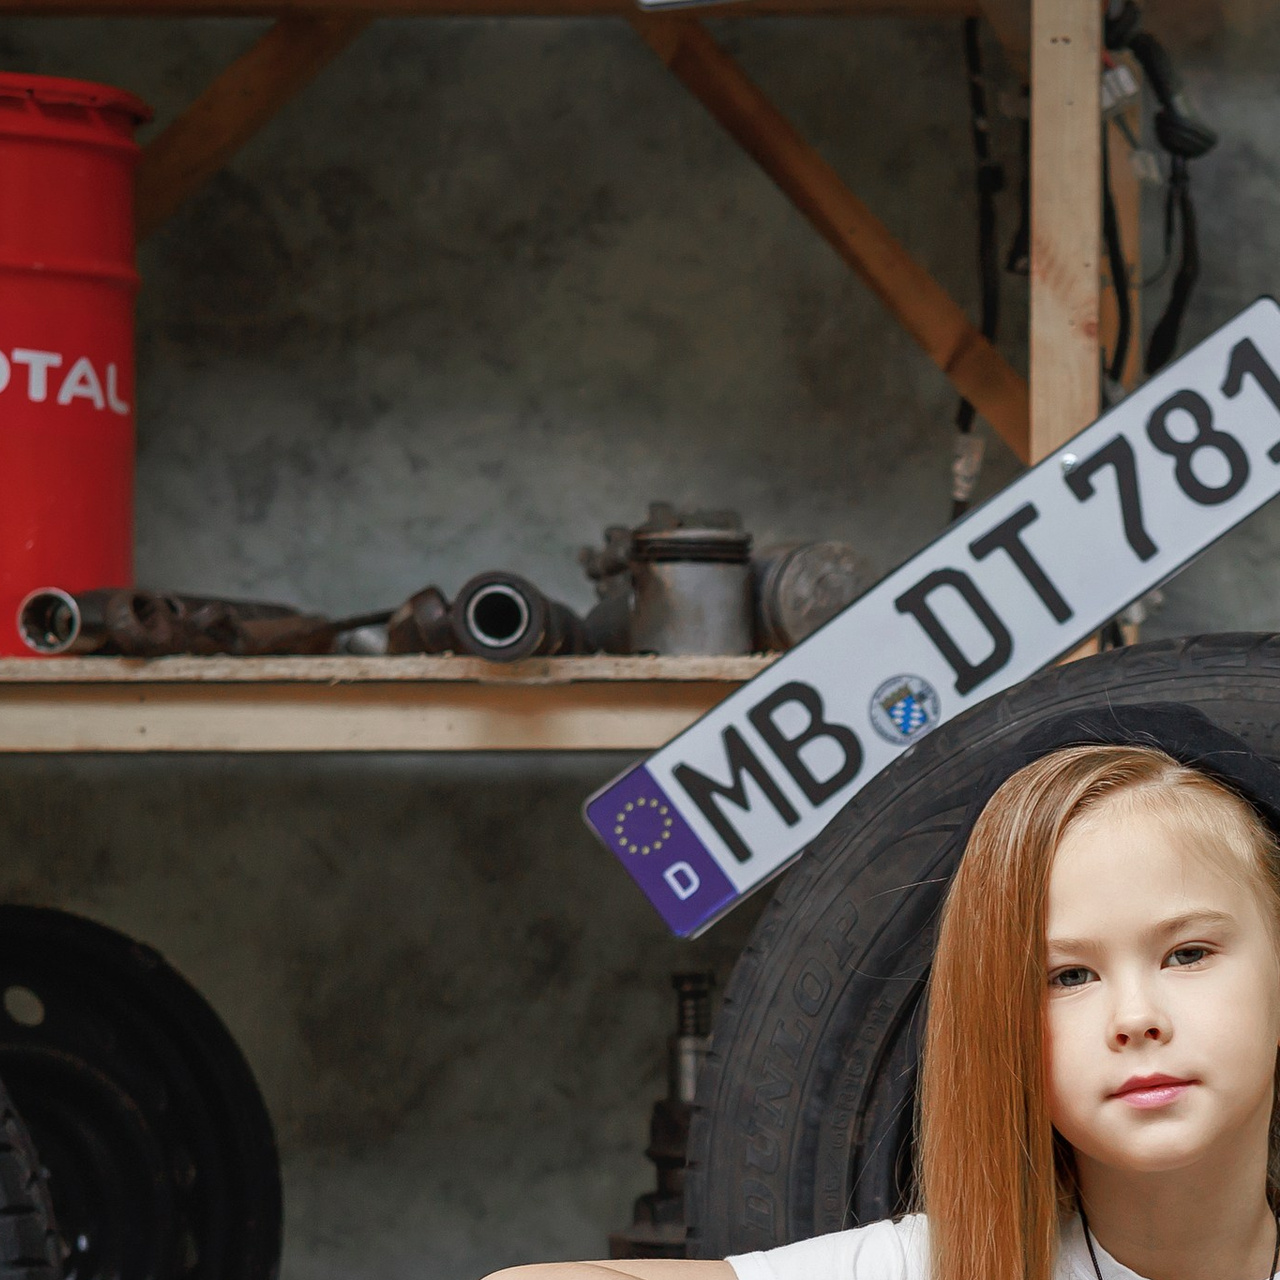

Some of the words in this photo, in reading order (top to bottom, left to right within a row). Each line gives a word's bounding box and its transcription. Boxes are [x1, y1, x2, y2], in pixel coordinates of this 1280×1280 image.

[0, 347, 130, 415] TAL
[672, 680, 865, 864] MB
[895, 502, 1075, 697] DT
[663, 859, 700, 902] D
[740, 898, 862, 1235] DUNLOP
